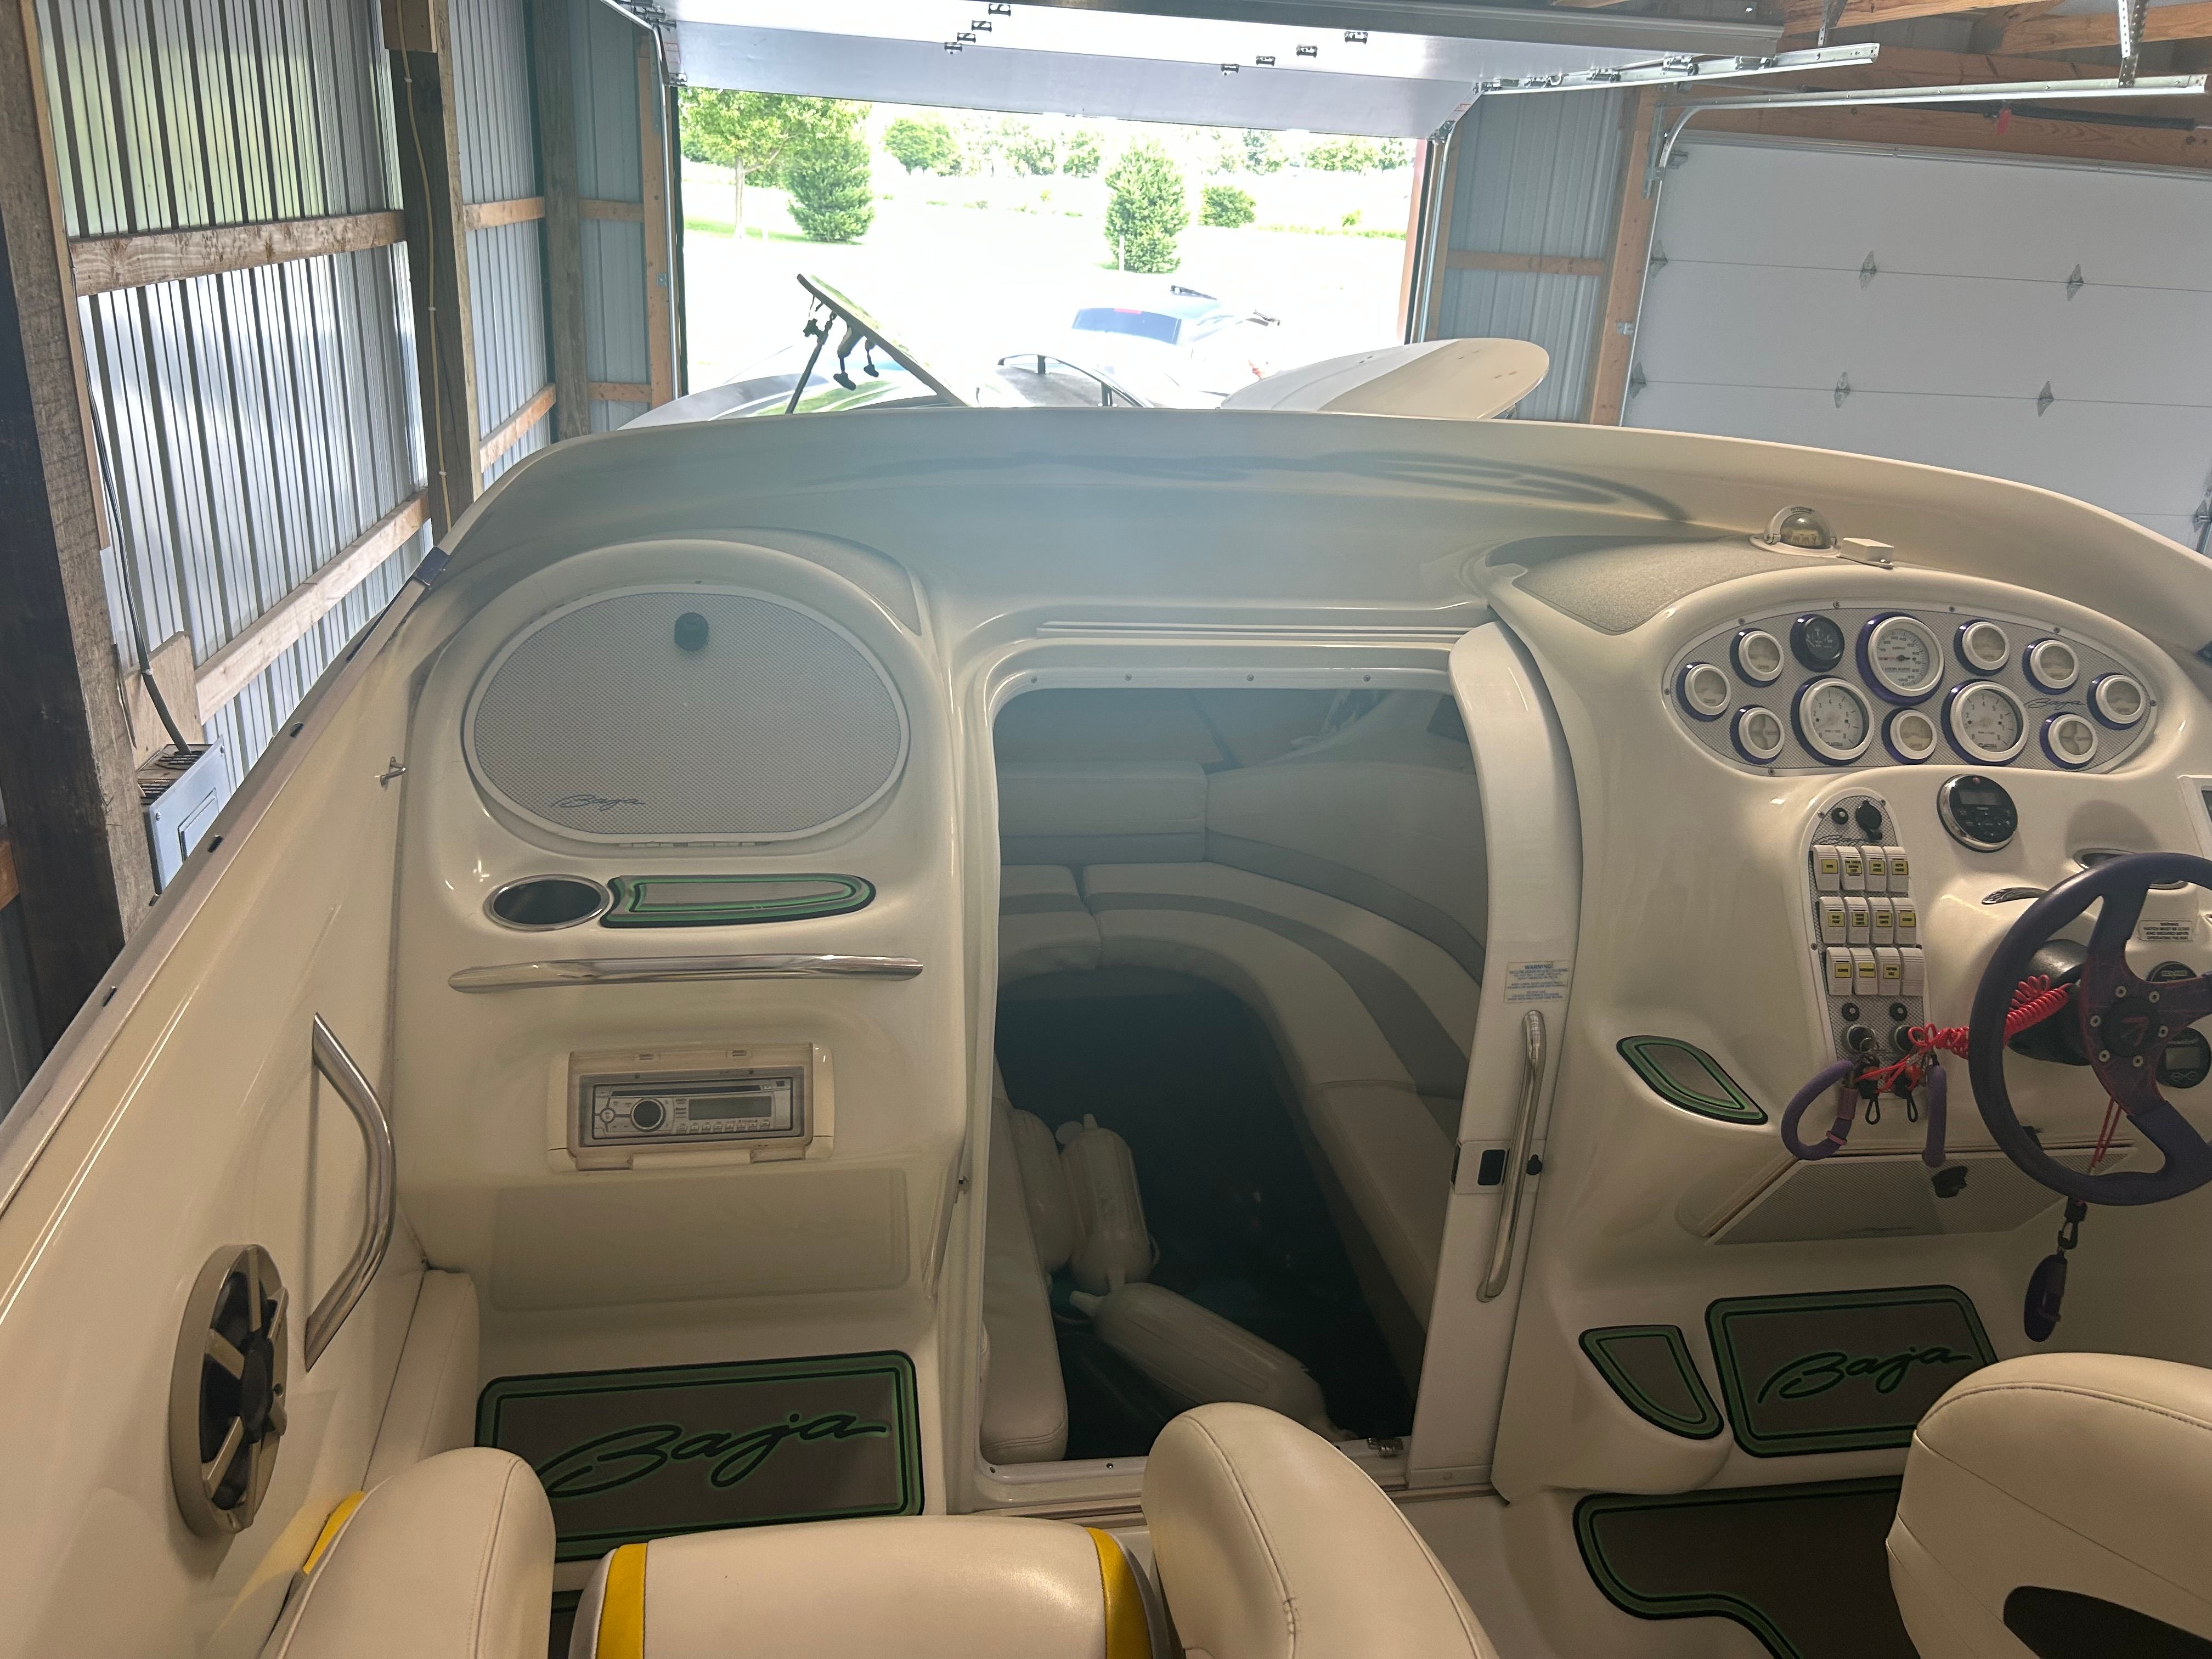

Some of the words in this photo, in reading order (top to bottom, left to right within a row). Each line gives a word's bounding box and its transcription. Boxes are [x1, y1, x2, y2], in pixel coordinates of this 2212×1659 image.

[550, 794, 646, 811] Baja
[1758, 1346, 1973, 1403] Baja
[536, 1413, 887, 1498] Baja
